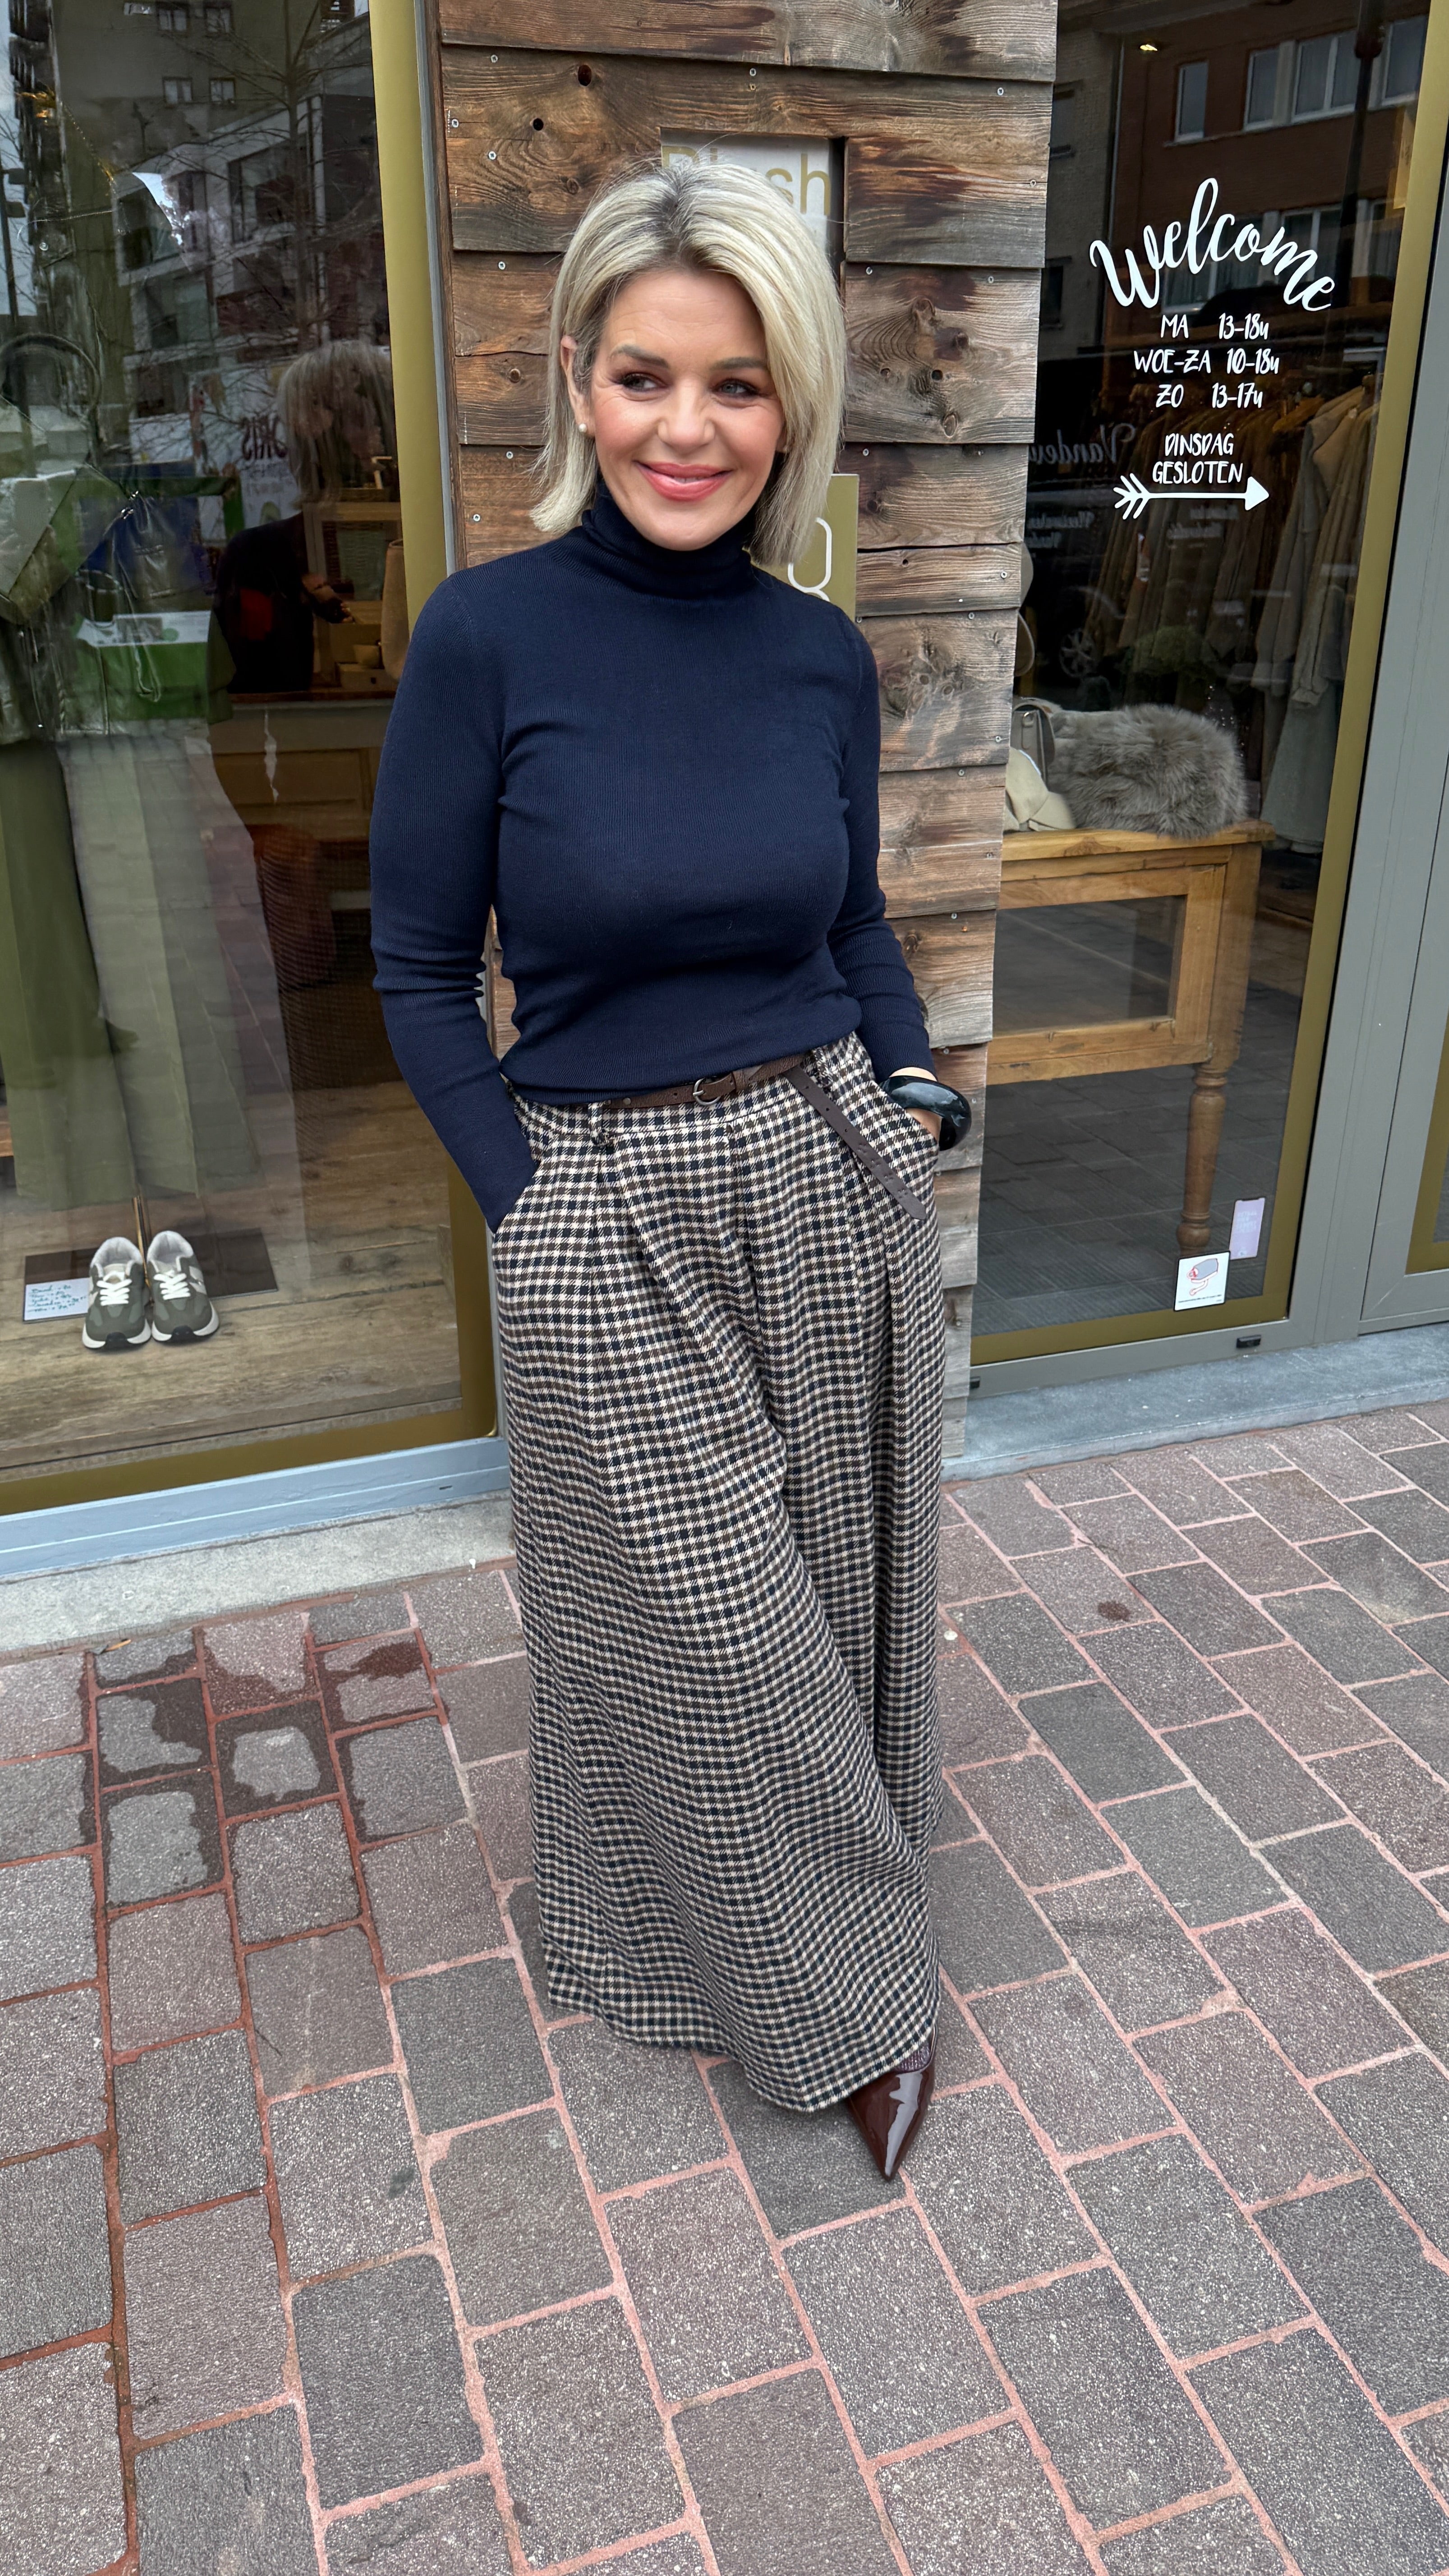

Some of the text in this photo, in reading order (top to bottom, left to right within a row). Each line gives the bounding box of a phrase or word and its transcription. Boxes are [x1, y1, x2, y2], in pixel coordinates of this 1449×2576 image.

[1090, 178, 1335, 311] Welcome
[1160, 313, 1269, 340] MA 13-18u
[1134, 349, 1211, 373] WOE-ZA
[1156, 382, 1263, 408] ZO 13-17u
[1165, 433, 1234, 456] DINSDAG
[1152, 461, 1243, 484] GESLOTEN
